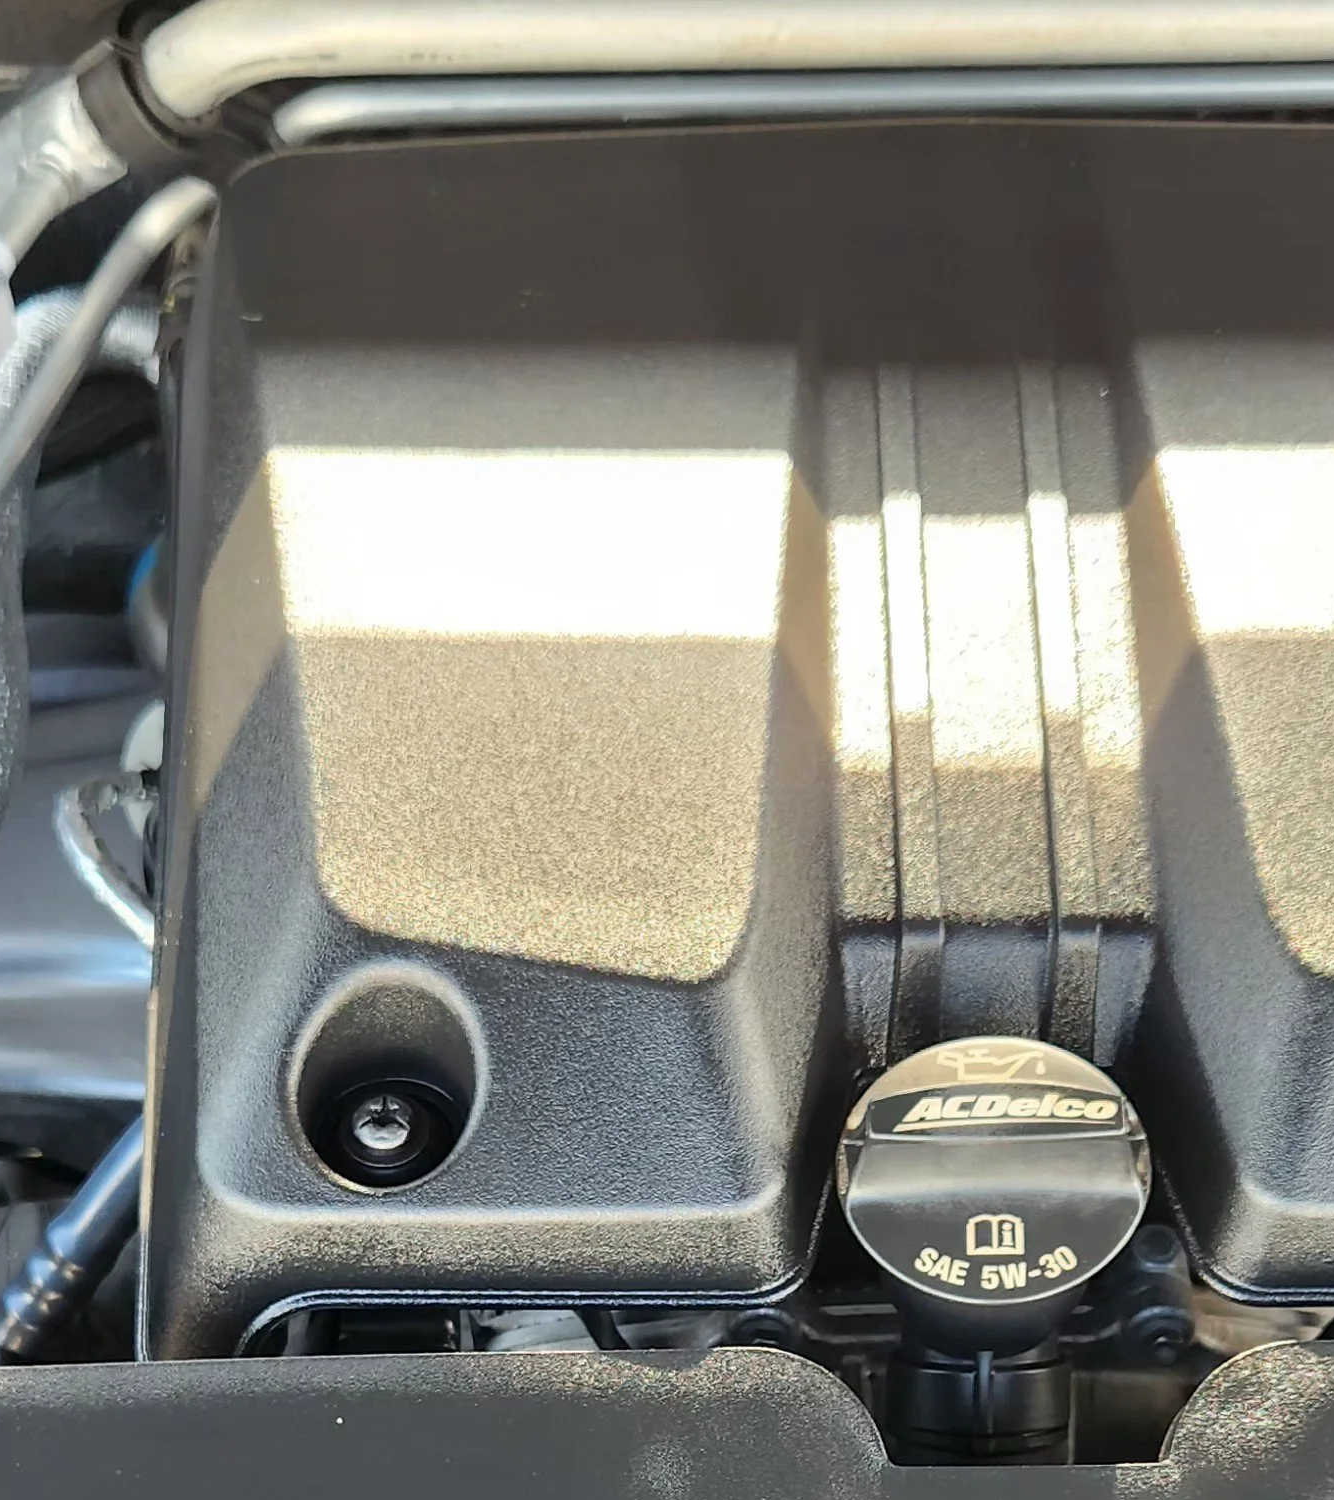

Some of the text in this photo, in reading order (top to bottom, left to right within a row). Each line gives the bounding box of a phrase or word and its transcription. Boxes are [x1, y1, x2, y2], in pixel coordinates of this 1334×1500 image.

[902, 1093, 1119, 1123] ACDelco
[914, 1246, 1079, 1291] SAE 5W-30
